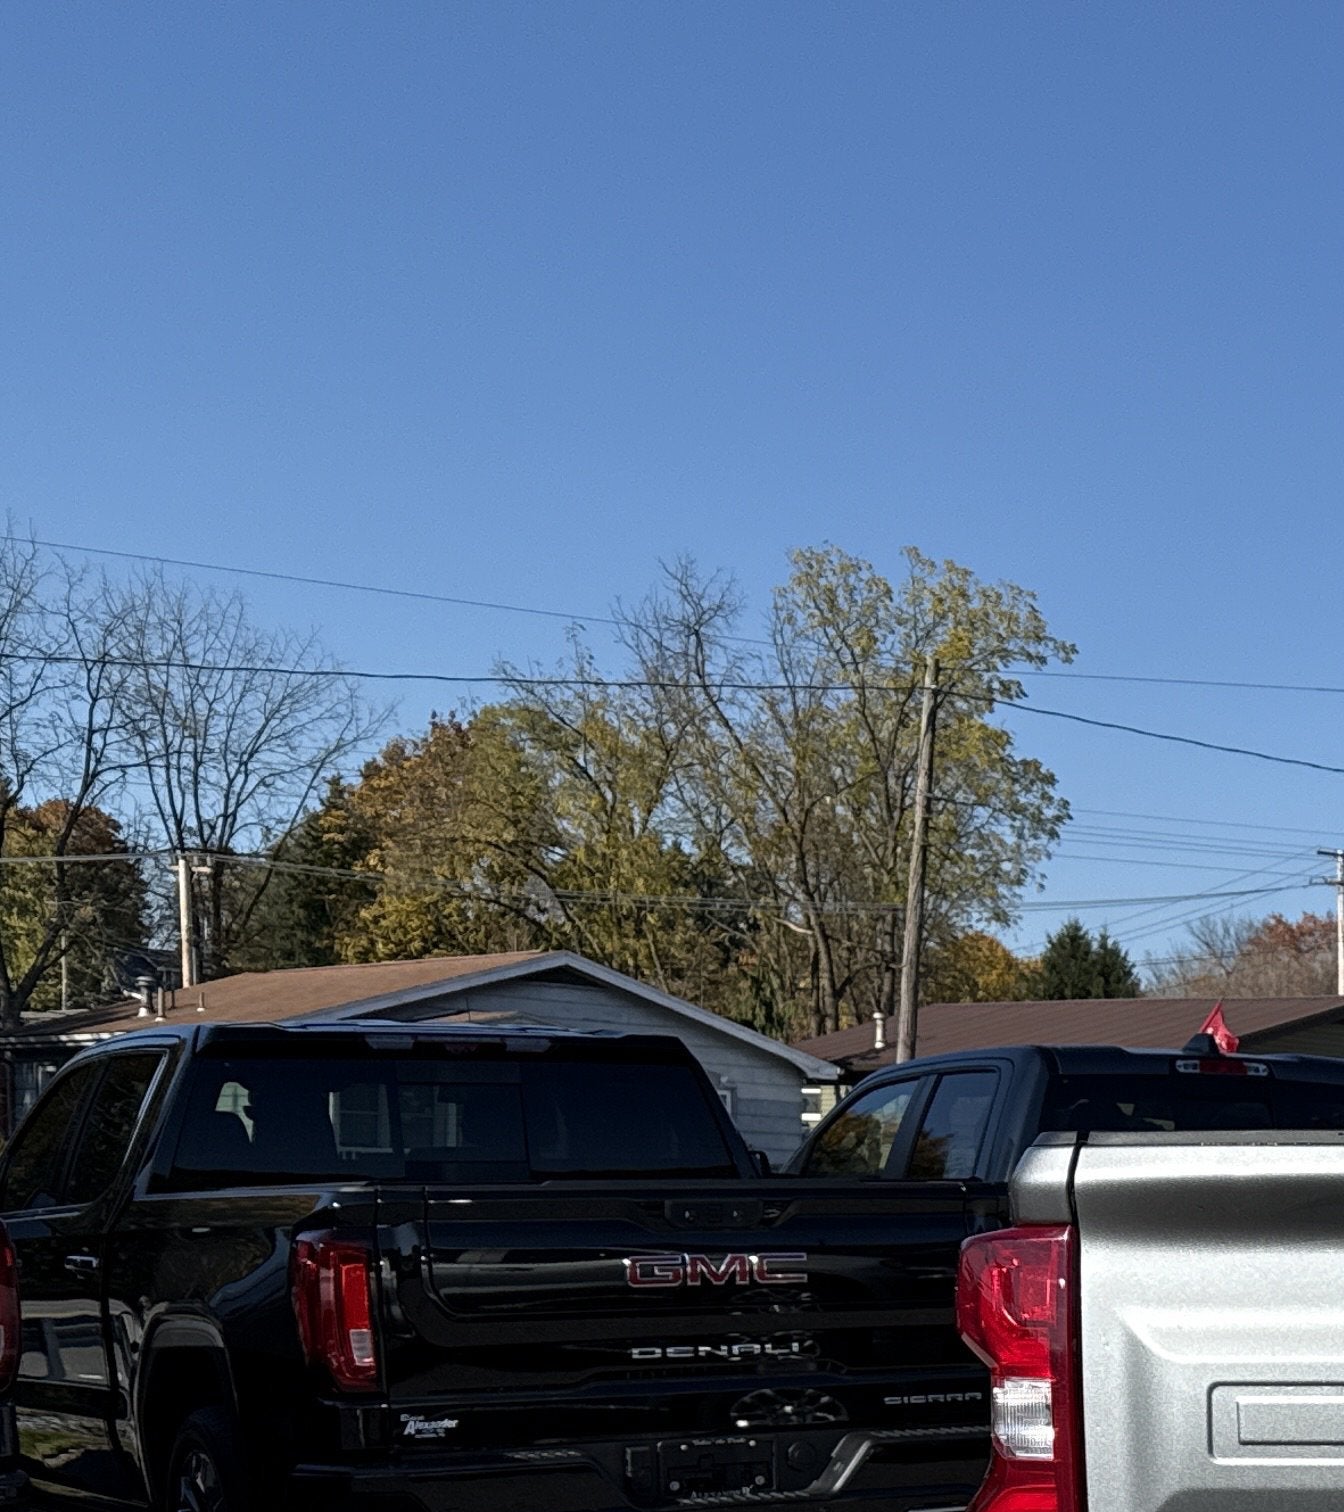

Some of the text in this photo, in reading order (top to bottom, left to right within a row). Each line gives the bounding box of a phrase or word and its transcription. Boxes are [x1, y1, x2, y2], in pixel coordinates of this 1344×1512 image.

[627, 1252, 808, 1288] GMC
[632, 1342, 800, 1359] DENALI
[883, 1392, 982, 1404] SIERRA
